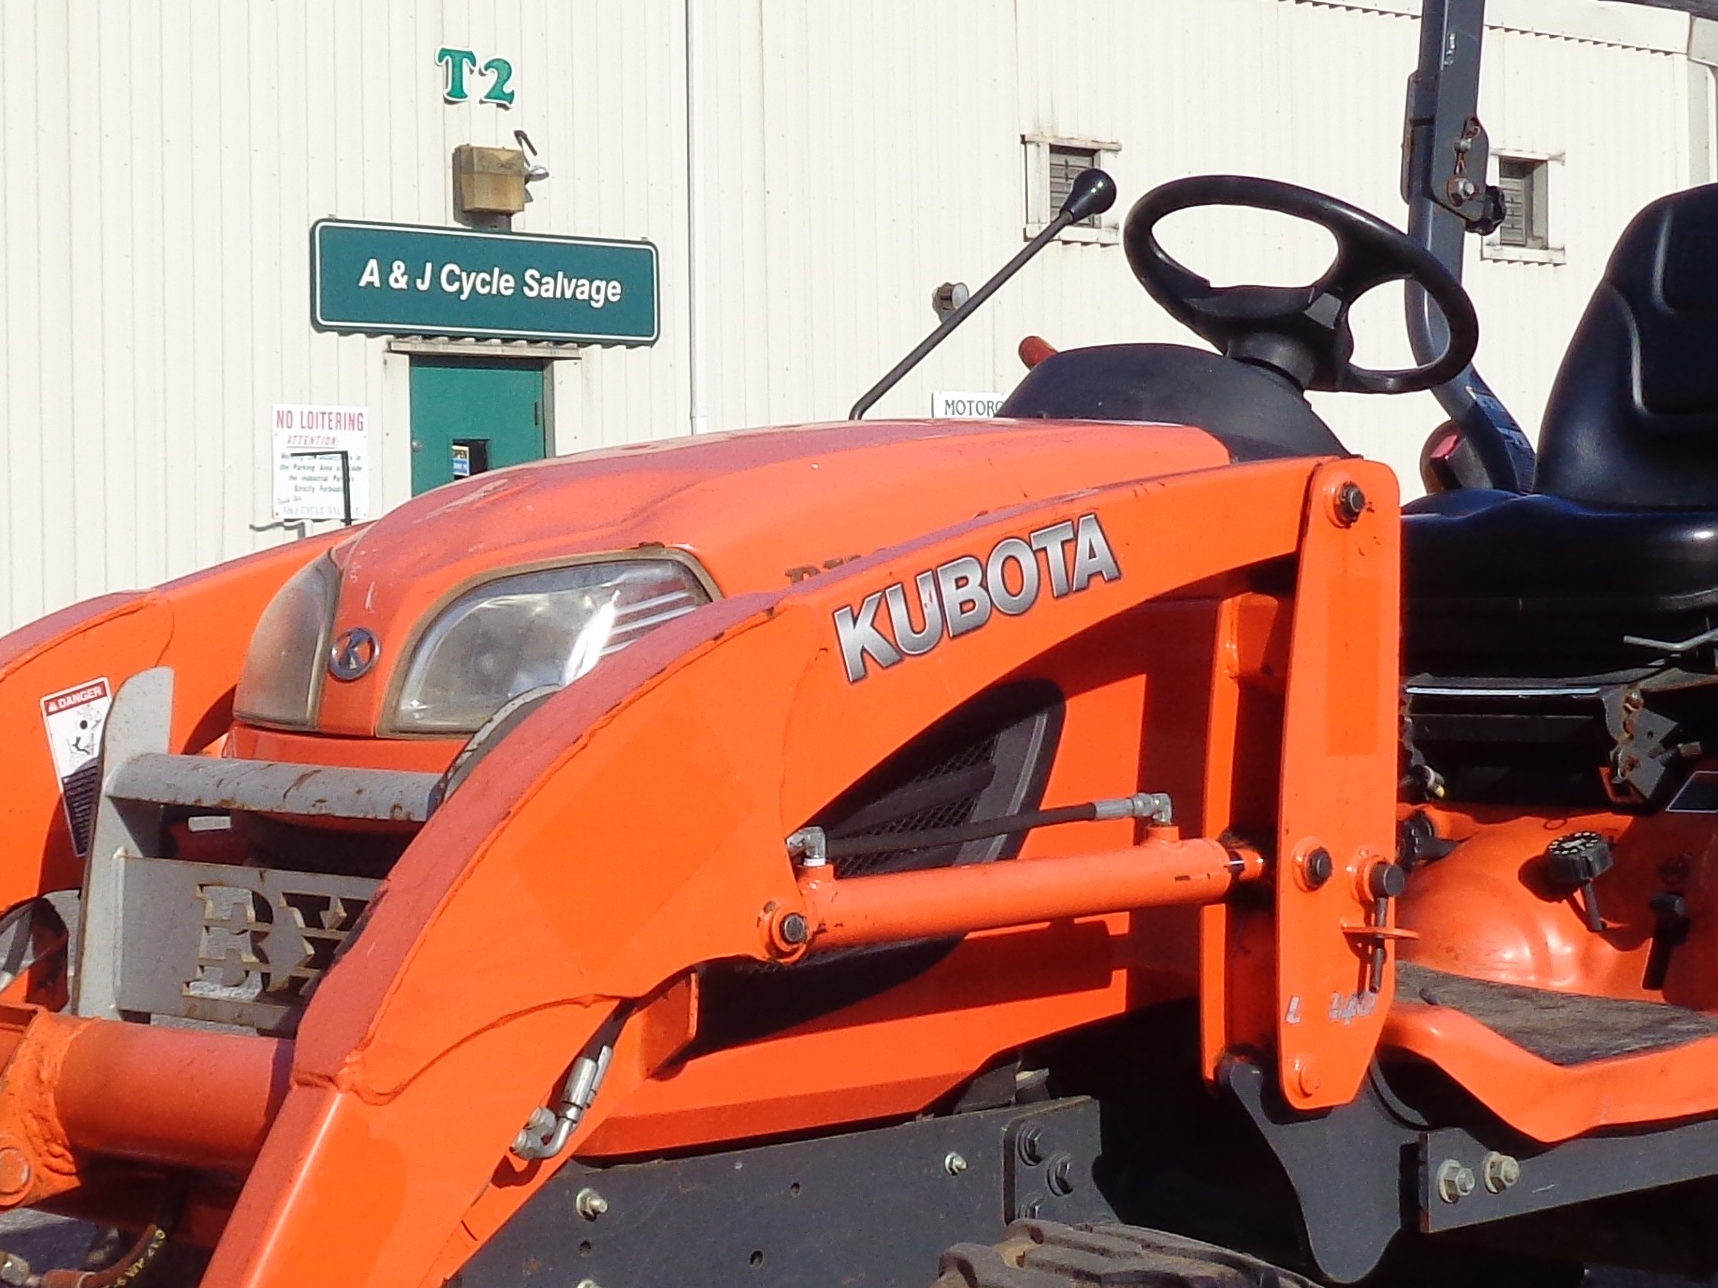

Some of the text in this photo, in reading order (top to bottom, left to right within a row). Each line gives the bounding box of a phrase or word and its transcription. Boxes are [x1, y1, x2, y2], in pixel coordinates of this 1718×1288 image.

[436, 47, 516, 105] T2
[359, 258, 622, 309] A & J Cycle Salvage
[276, 410, 364, 431] NO LOITERING
[944, 399, 1003, 416] MOTORC
[833, 513, 1121, 683] KUBOTA
[58, 686, 102, 710] DANGER
